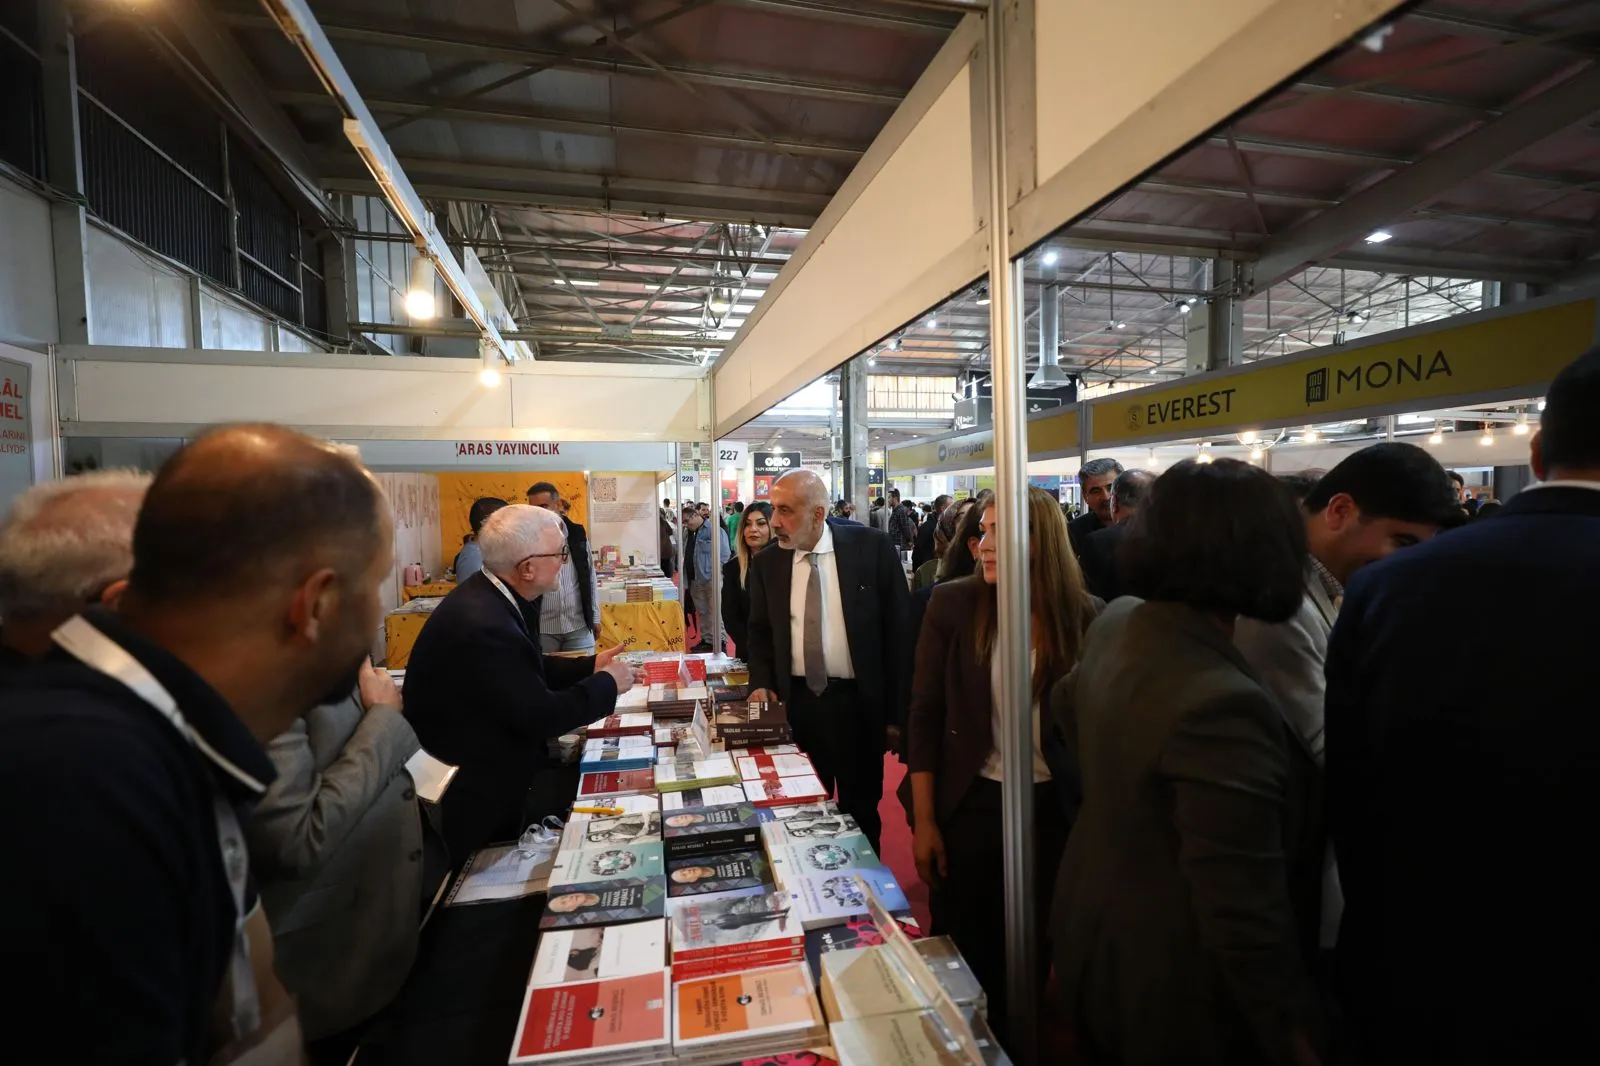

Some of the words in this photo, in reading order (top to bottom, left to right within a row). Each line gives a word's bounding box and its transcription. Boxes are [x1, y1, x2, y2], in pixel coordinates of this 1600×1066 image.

[1337, 350, 1452, 394] MONA
[0, 378, 23, 399] ÂL
[1147, 388, 1237, 425] EVEREST
[458, 443, 493, 455] ARAS
[495, 443, 560, 455] YAYINCILIK
[719, 450, 739, 461] 227
[681, 475, 694, 483] 228
[622, 635, 637, 646] RAS
